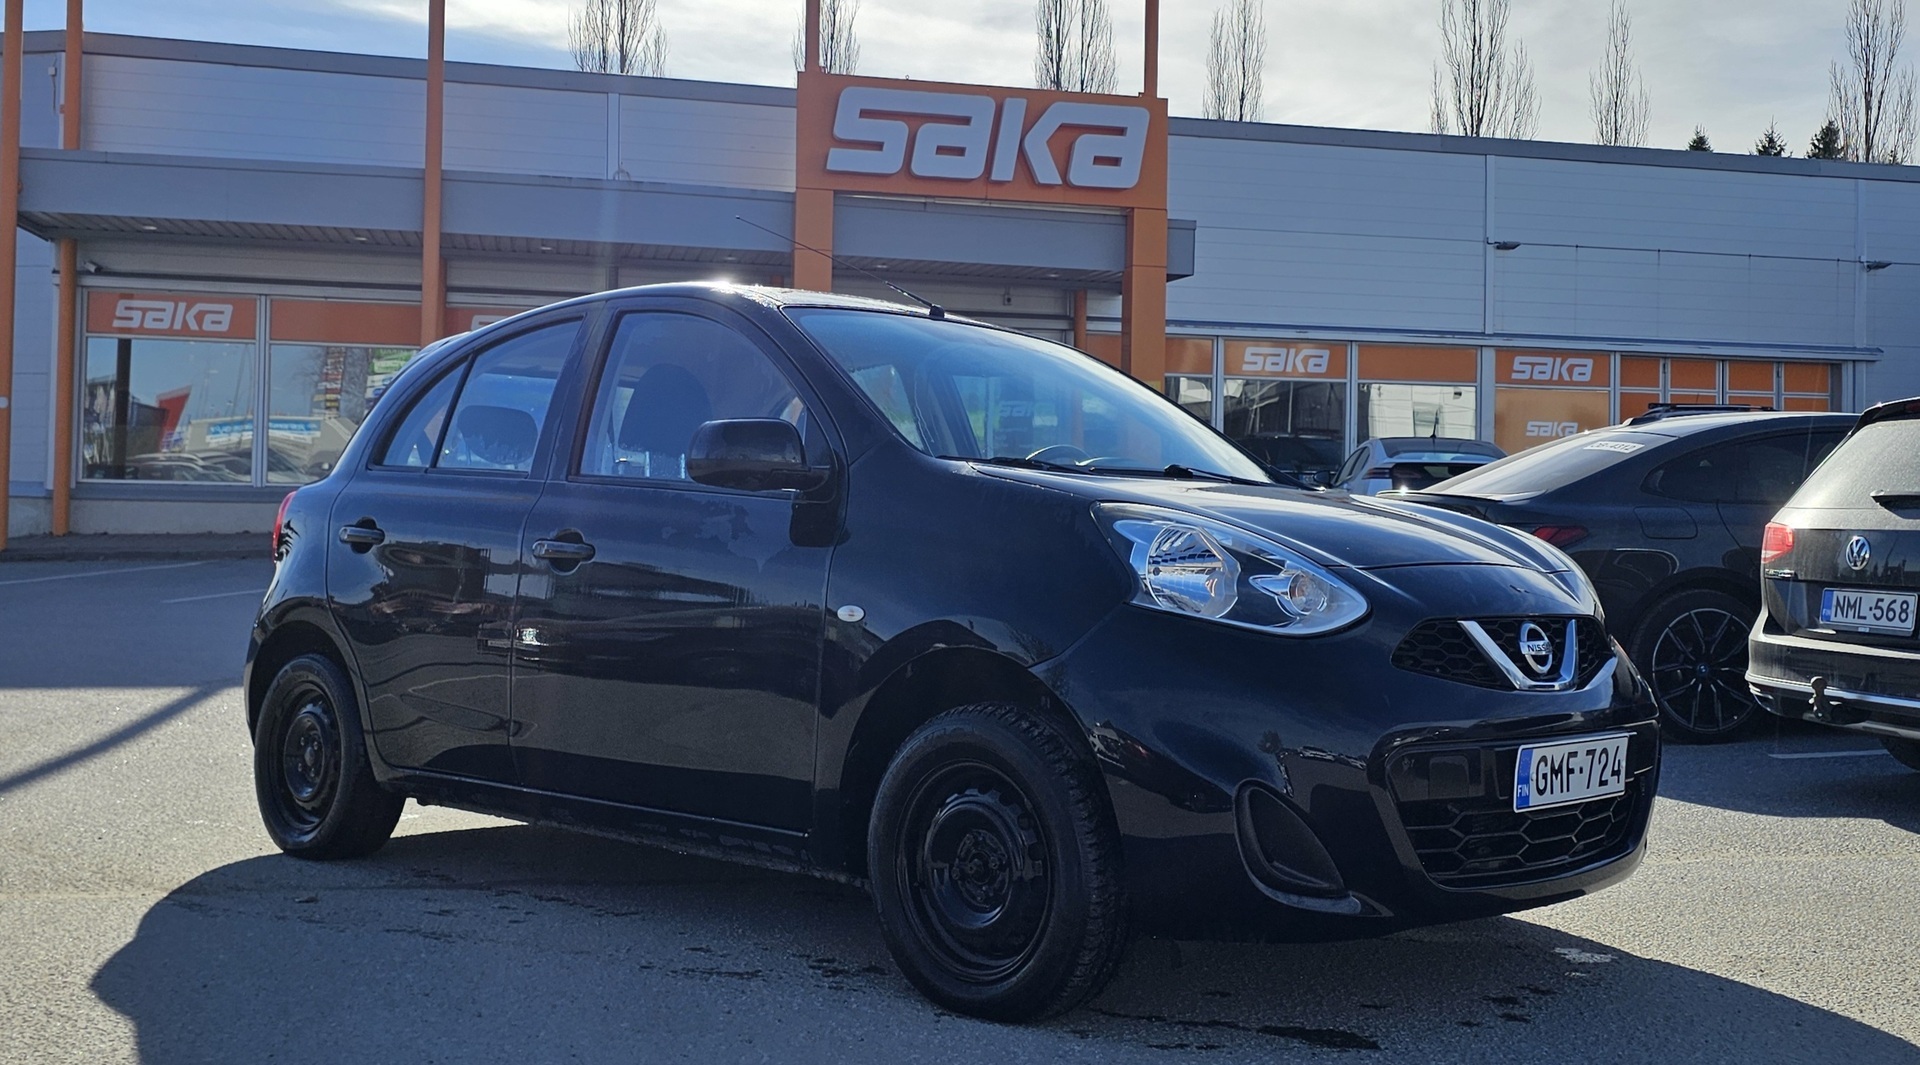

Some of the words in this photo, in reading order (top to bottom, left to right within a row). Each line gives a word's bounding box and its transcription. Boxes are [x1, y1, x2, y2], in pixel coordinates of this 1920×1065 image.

[1834, 595, 1910, 624] NML-568
[1535, 745, 1621, 796] GMF-724
[1517, 784, 1530, 797] FIN
